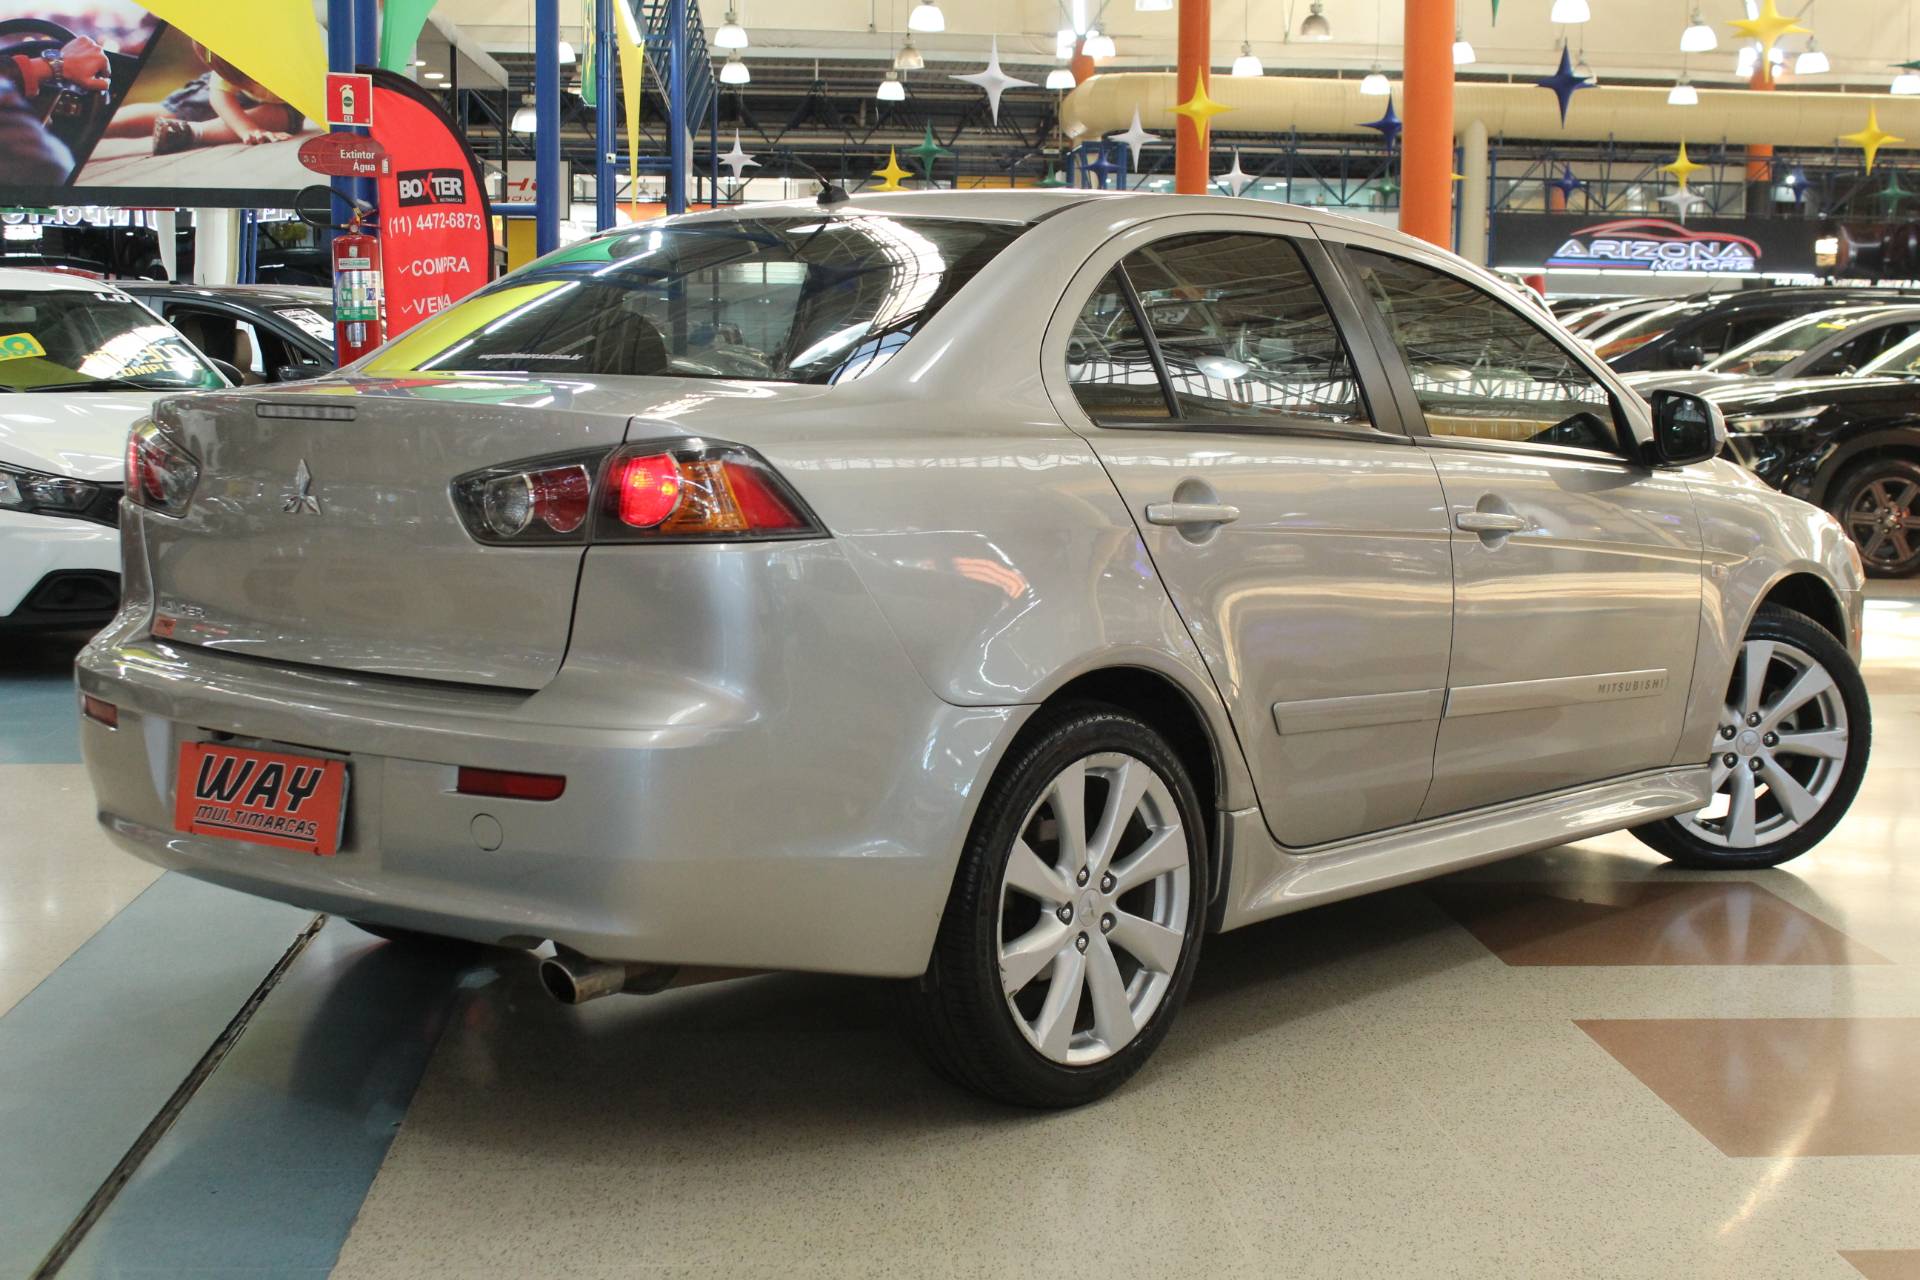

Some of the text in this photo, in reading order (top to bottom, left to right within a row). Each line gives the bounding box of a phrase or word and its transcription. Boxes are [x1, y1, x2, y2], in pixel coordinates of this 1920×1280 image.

[340, 149, 375, 159] Extintor
[353, 160, 375, 172] Água
[399, 172, 463, 203] BOXTER
[388, 212, 481, 238] (11) 4472-6873
[1553, 239, 1754, 260] ARIZONA
[411, 256, 470, 277] COMPRA
[1649, 258, 1755, 271] MOTORS
[1598, 678, 1665, 694] MITSUBISHI
[195, 753, 325, 813] WAY
[195, 805, 318, 836] MULTIMARCAS
